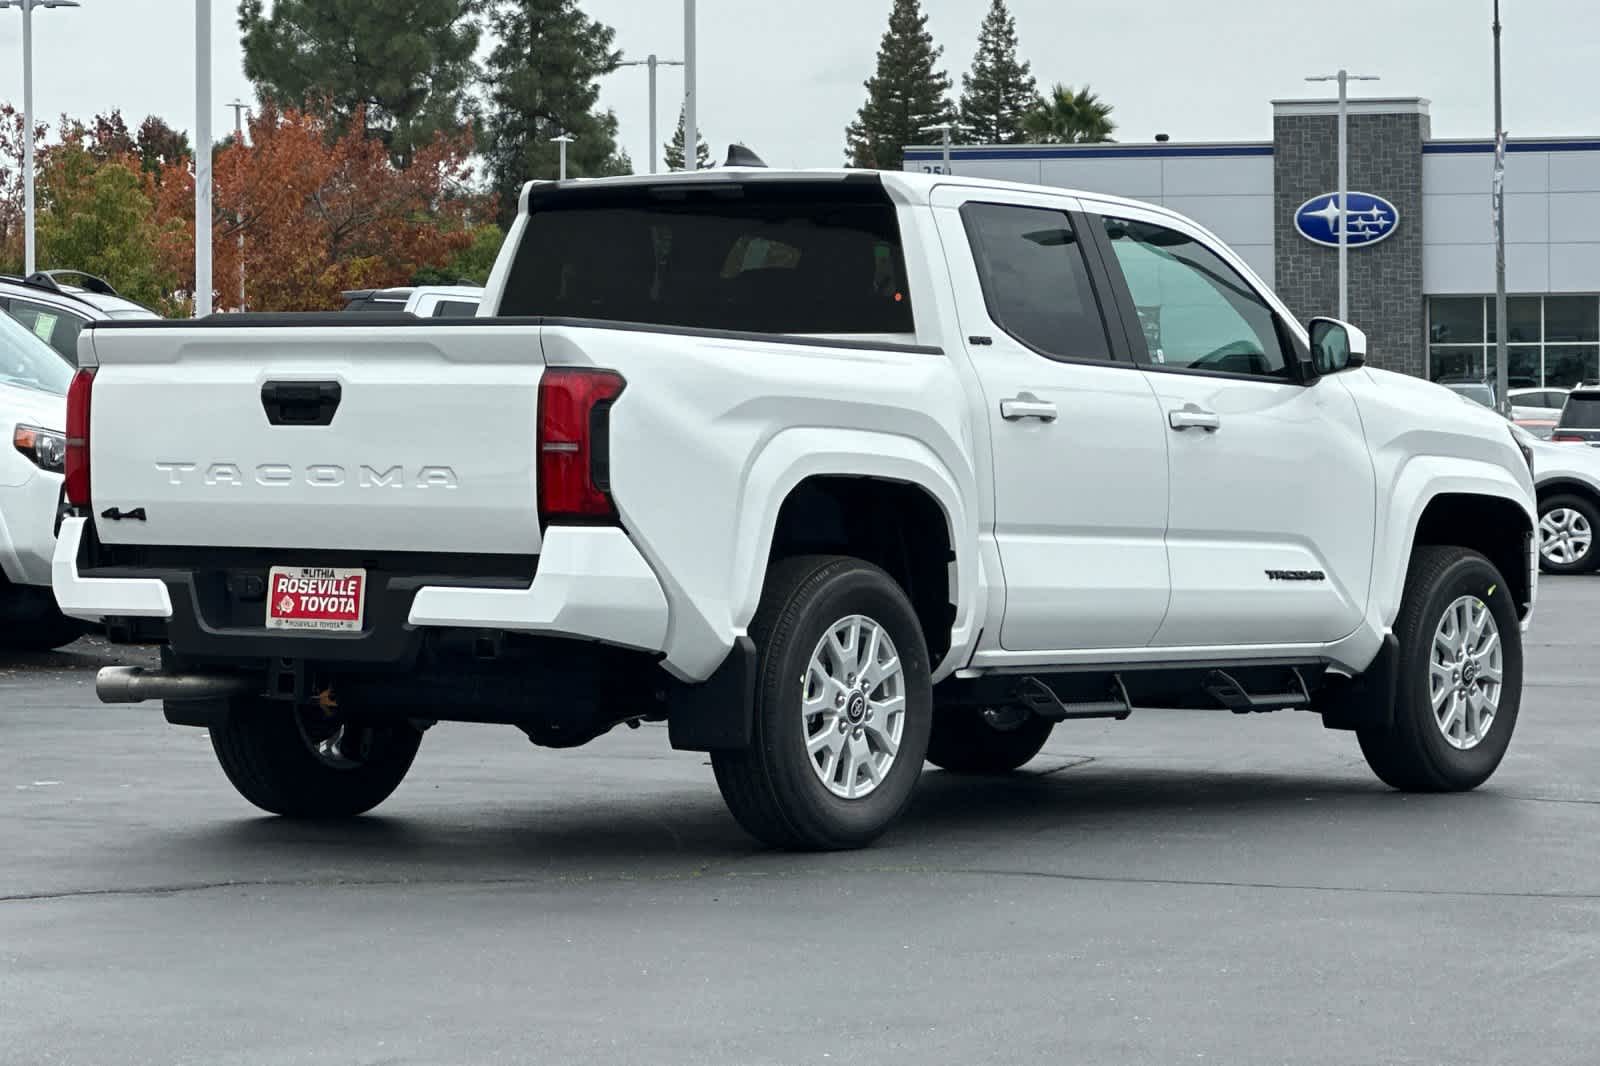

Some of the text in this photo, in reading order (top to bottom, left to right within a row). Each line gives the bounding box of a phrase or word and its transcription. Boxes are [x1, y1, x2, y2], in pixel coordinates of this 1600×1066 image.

[155, 462, 458, 489] TACOMA
[309, 569, 335, 578] LITHIA
[277, 579, 357, 595] ROSEVILLE
[300, 596, 355, 613] TOYOTA
